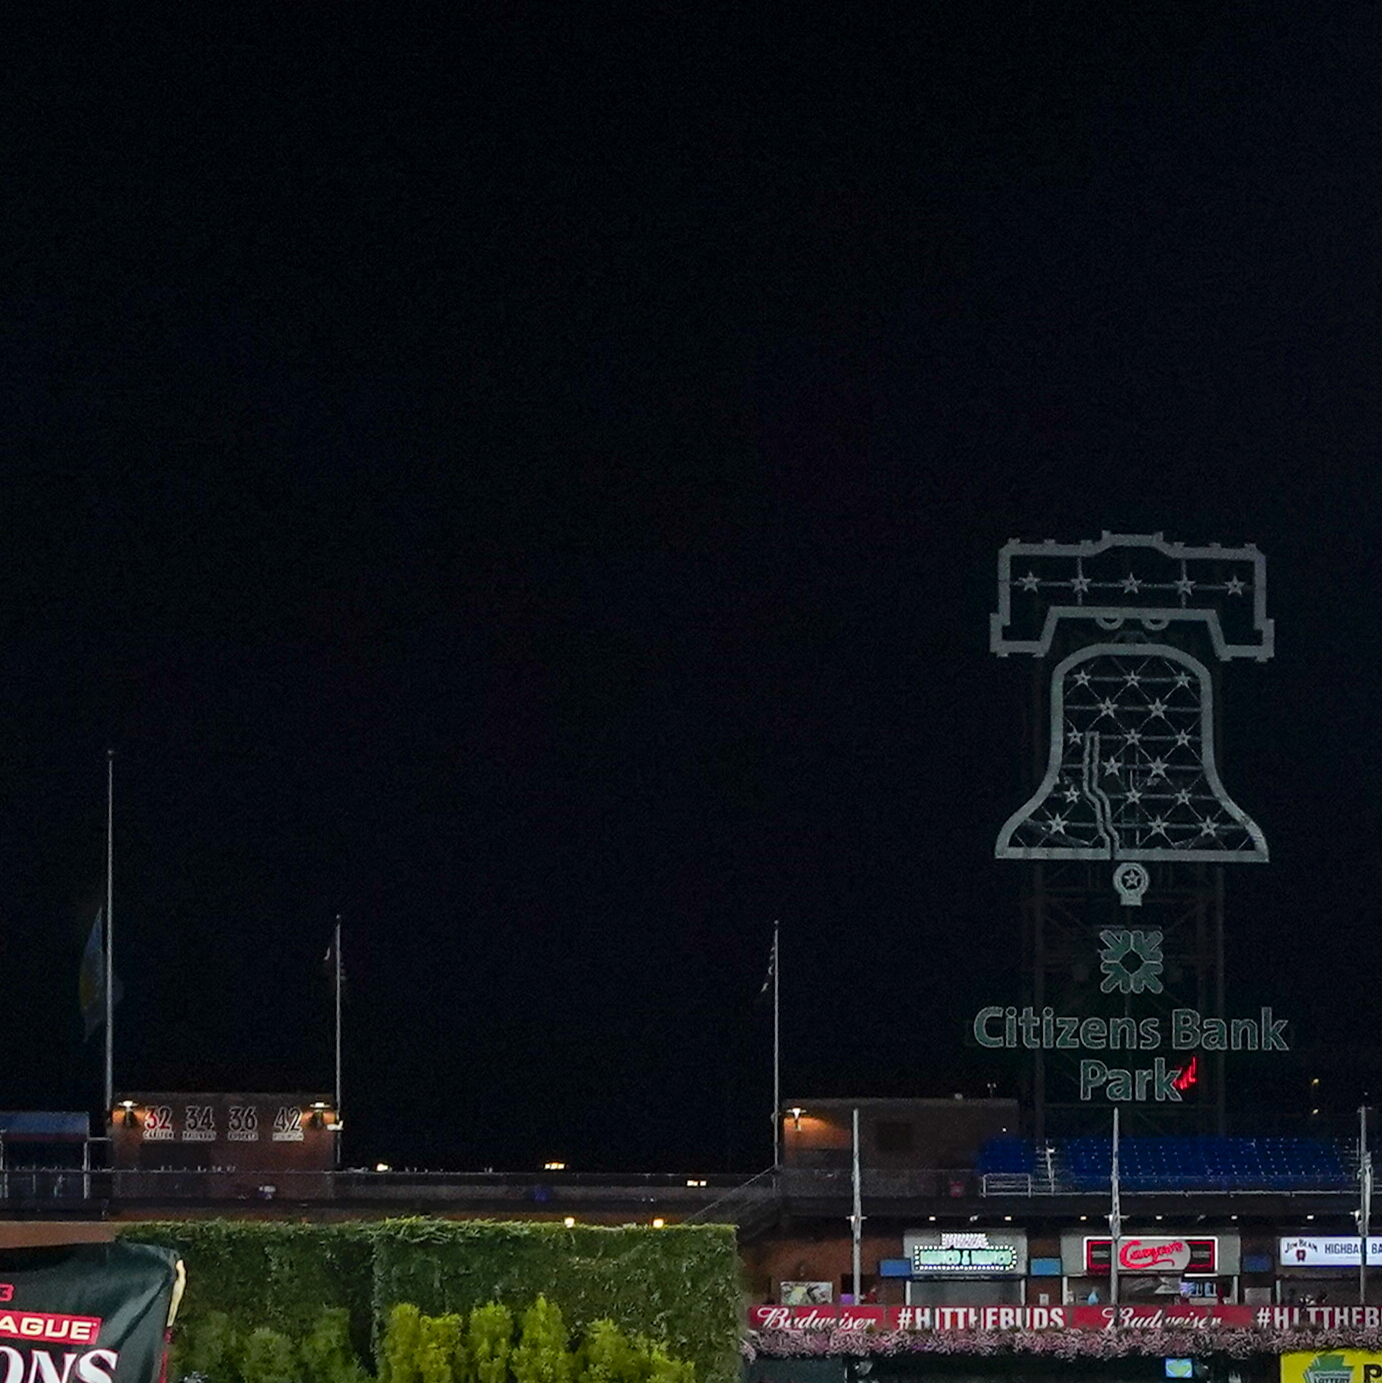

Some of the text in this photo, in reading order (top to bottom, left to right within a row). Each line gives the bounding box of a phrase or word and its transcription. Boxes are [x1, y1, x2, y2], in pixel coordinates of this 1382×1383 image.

[973, 1006, 1290, 1051] Citizens Bank
[1079, 1058, 1183, 1101] Park
[144, 1106, 173, 1130] 32
[185, 1106, 216, 1130] 34
[228, 1106, 258, 1131] 36
[274, 1106, 304, 1132] 42
[1324, 1242, 1365, 1255] HIGHBA
[897, 1306, 1065, 1330] #HITTHEBUDS
